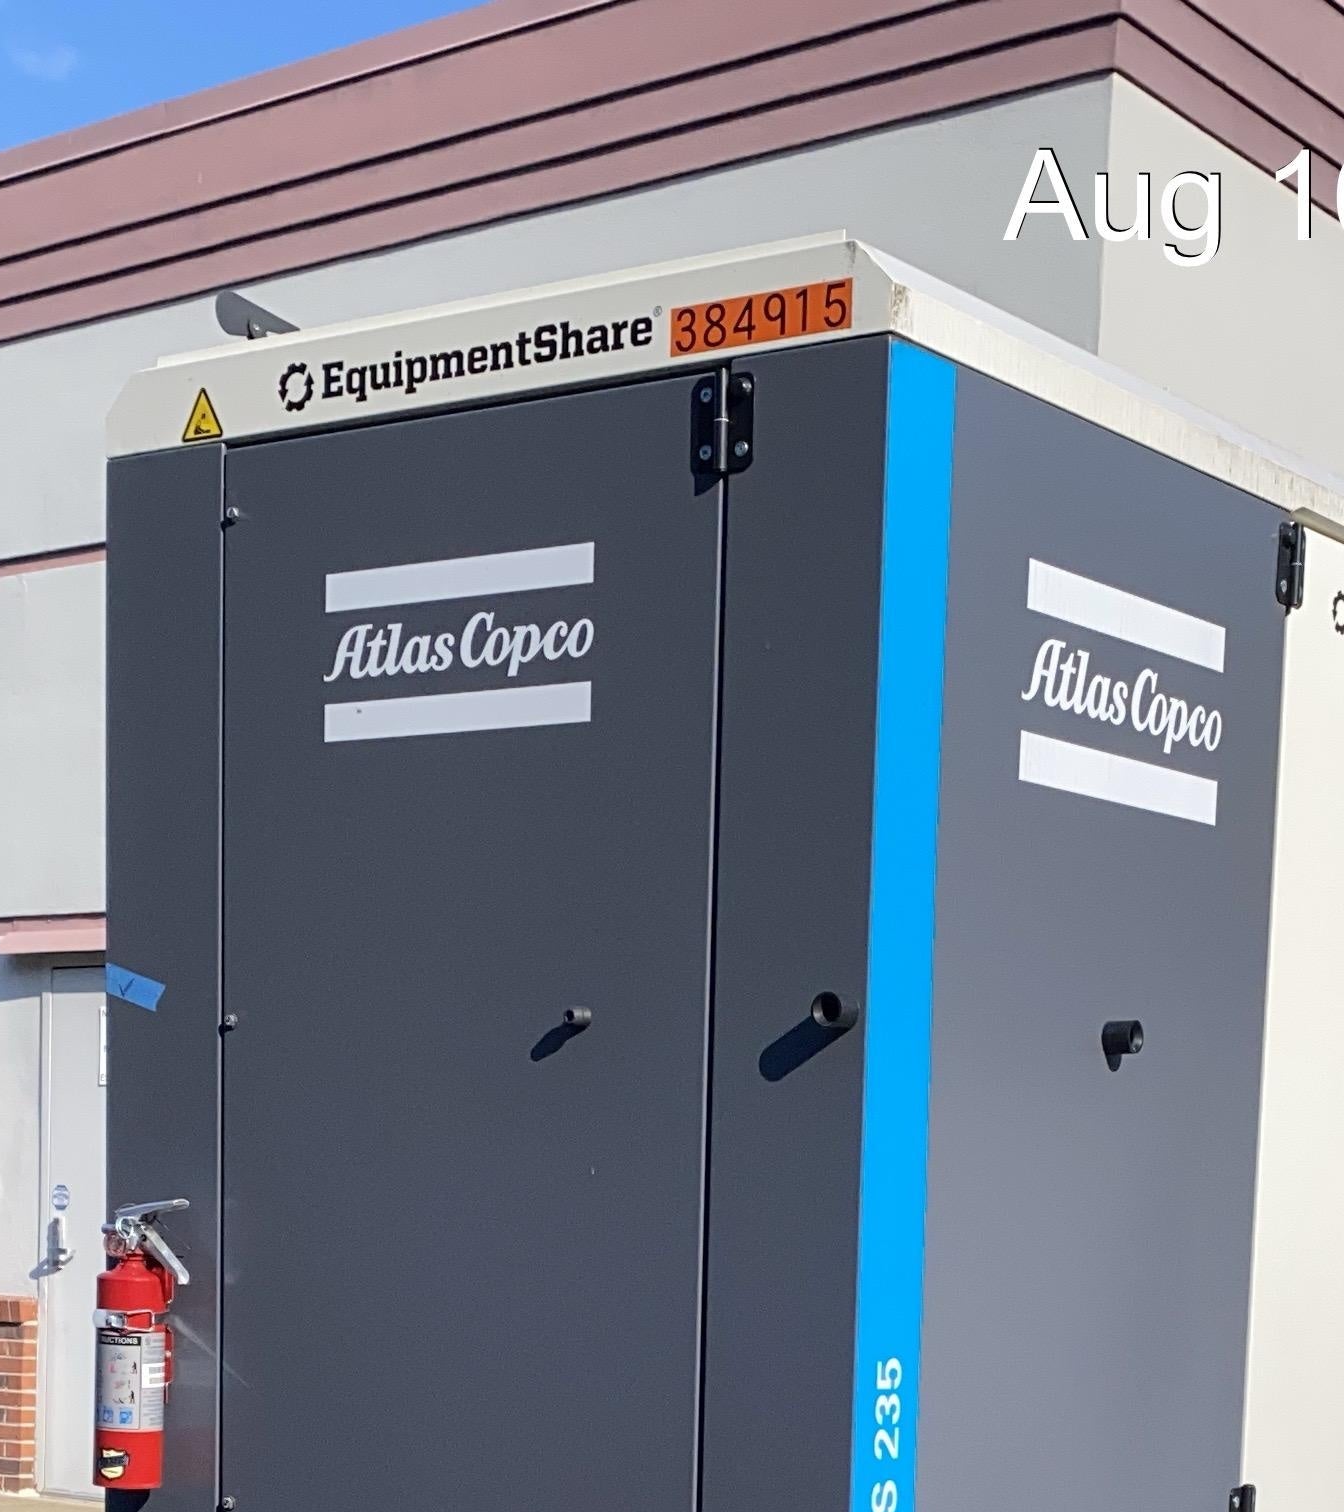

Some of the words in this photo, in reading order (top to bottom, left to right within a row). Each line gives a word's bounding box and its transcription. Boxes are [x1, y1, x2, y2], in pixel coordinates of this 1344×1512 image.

[320, 314, 653, 402] EquipmentShare
[675, 282, 847, 353] 384915
[323, 622, 455, 682] Atlas
[460, 611, 595, 677] Copco
[1021, 638, 1129, 725] Atlas
[1131, 668, 1222, 754] Copco
[873, 1357, 903, 1461] 235
